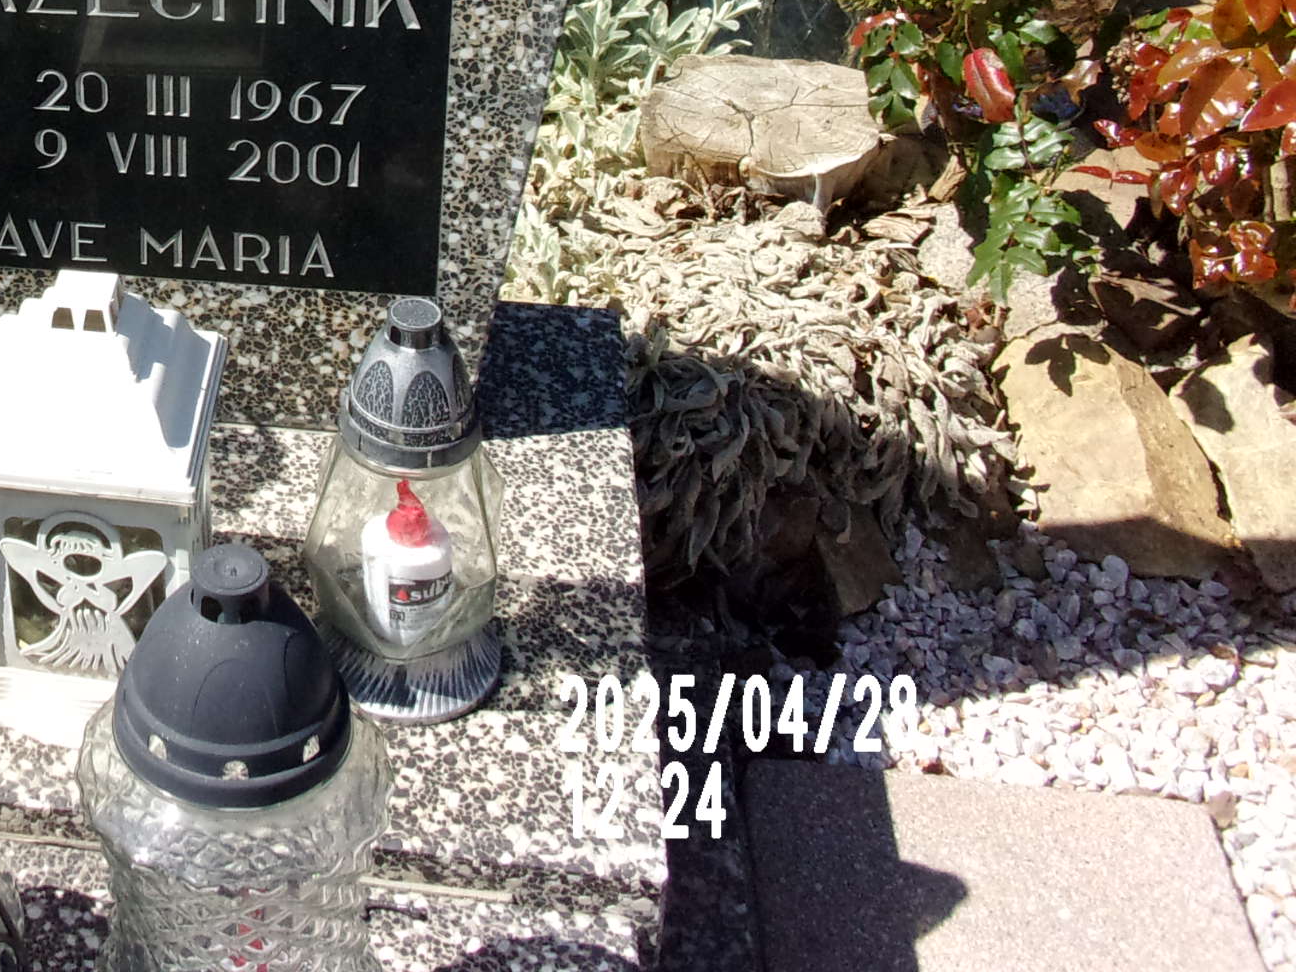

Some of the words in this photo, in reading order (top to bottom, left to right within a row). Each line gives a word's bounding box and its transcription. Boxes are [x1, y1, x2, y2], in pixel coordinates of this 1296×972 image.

[35, 69, 110, 114] 20
[145, 73, 191, 118] III
[229, 75, 367, 127] 1967
[34, 128, 68, 170] 9
[106, 131, 188, 178] VIII
[226, 139, 361, 188] 2001
[139, 225, 335, 279] MARIA
